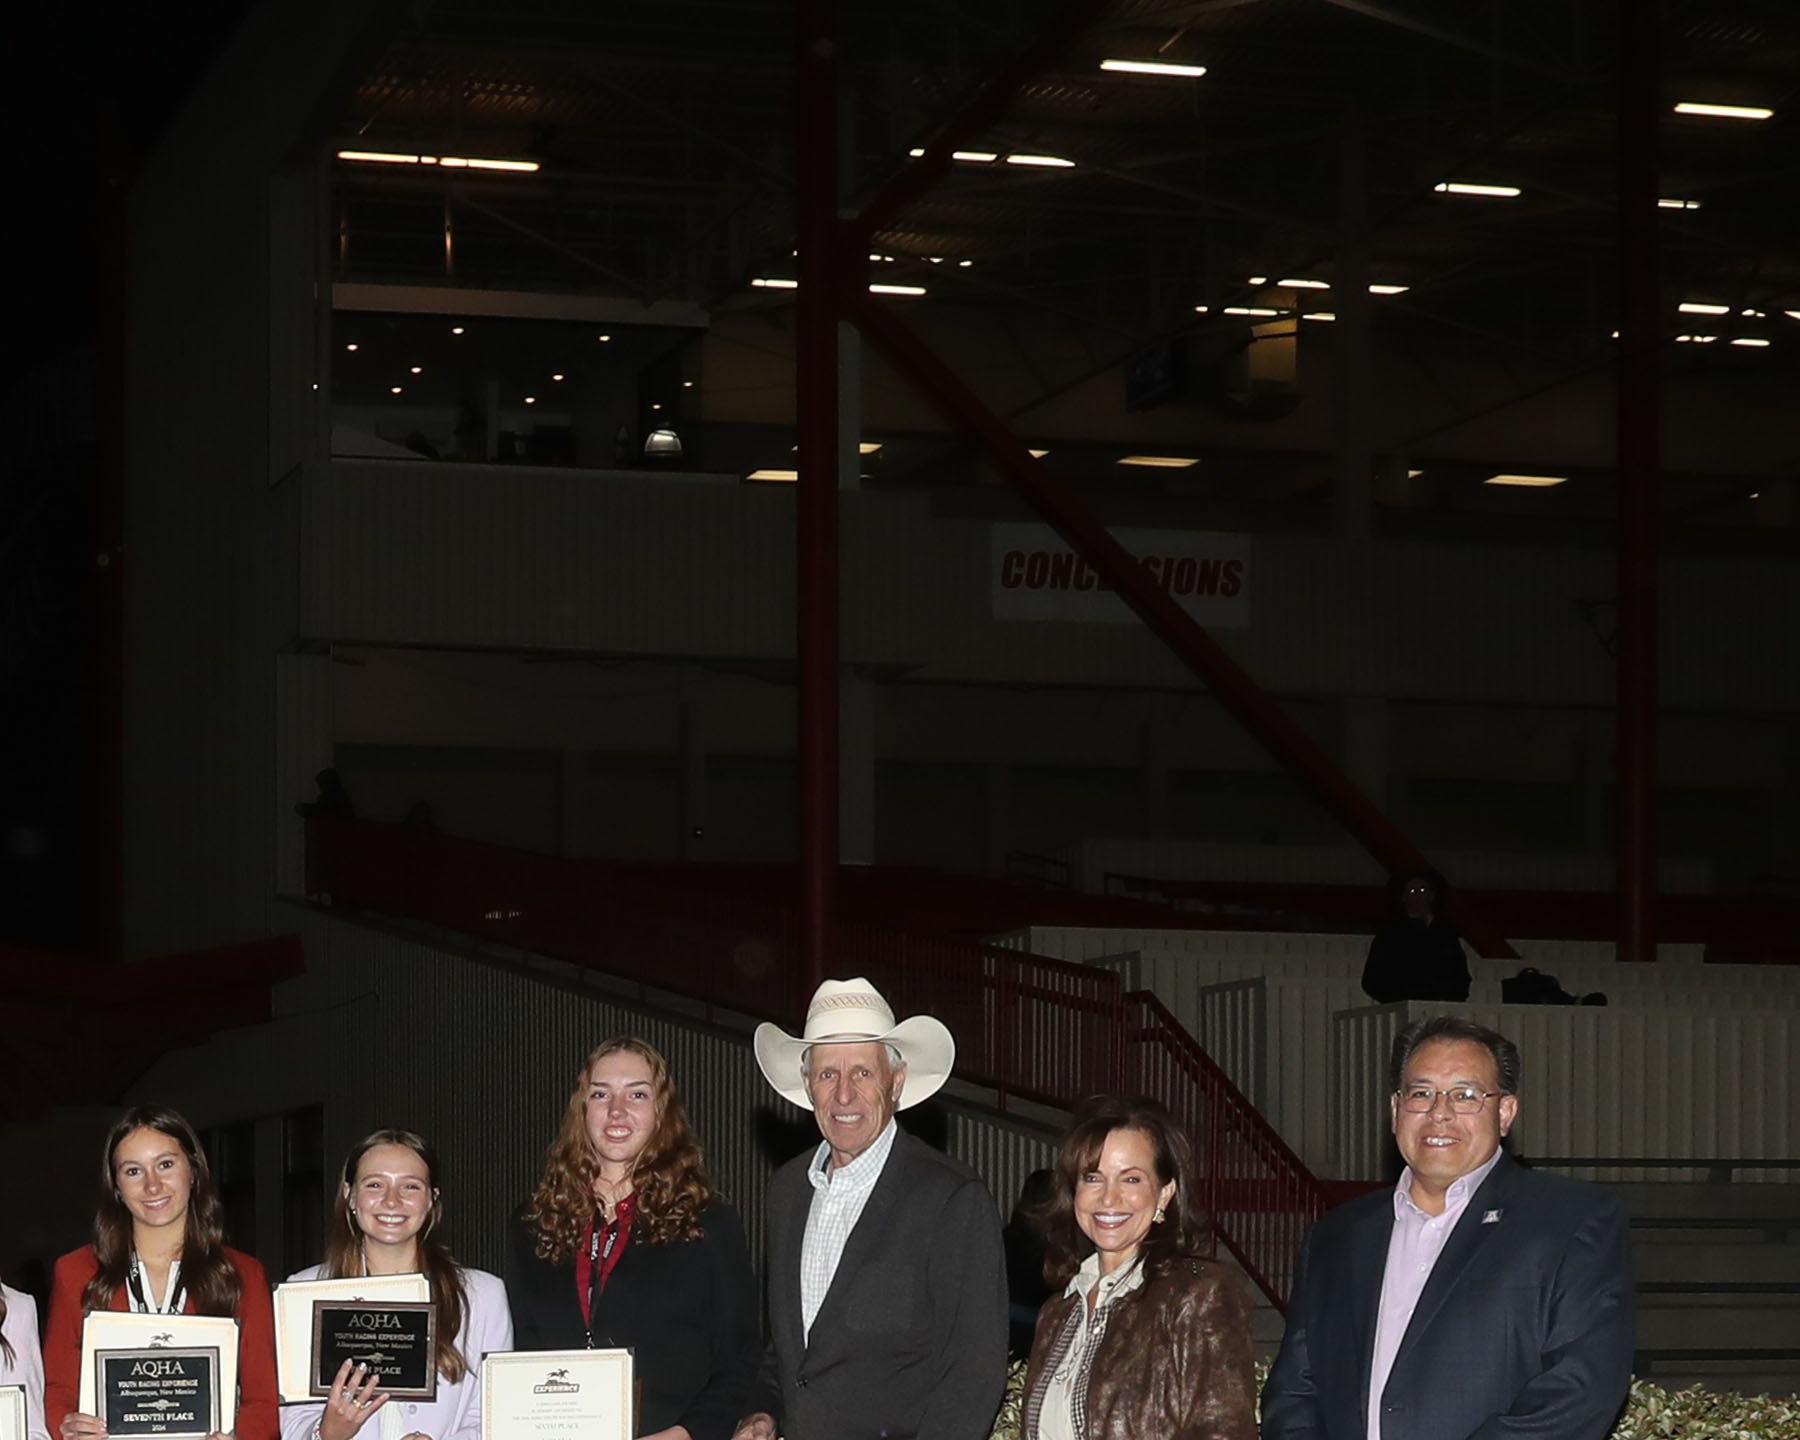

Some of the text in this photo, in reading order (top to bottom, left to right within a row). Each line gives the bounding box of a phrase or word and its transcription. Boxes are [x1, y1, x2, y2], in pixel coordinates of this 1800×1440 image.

[1001, 550, 1243, 597] CONCSIONS
[347, 1313, 403, 1331] AQHA
[334, 1332, 353, 1340] YOUTH
[378, 1333, 415, 1341] EXPERIENCE
[130, 1360, 185, 1378] AQHA
[374, 1366, 402, 1375] PLACE
[138, 1380, 160, 1388] RACING
[161, 1379, 199, 1387] EXPERIENCE
[535, 1384, 578, 1393] EXPERIENCE
[123, 1412, 194, 1422] SEVENTH PLACE
